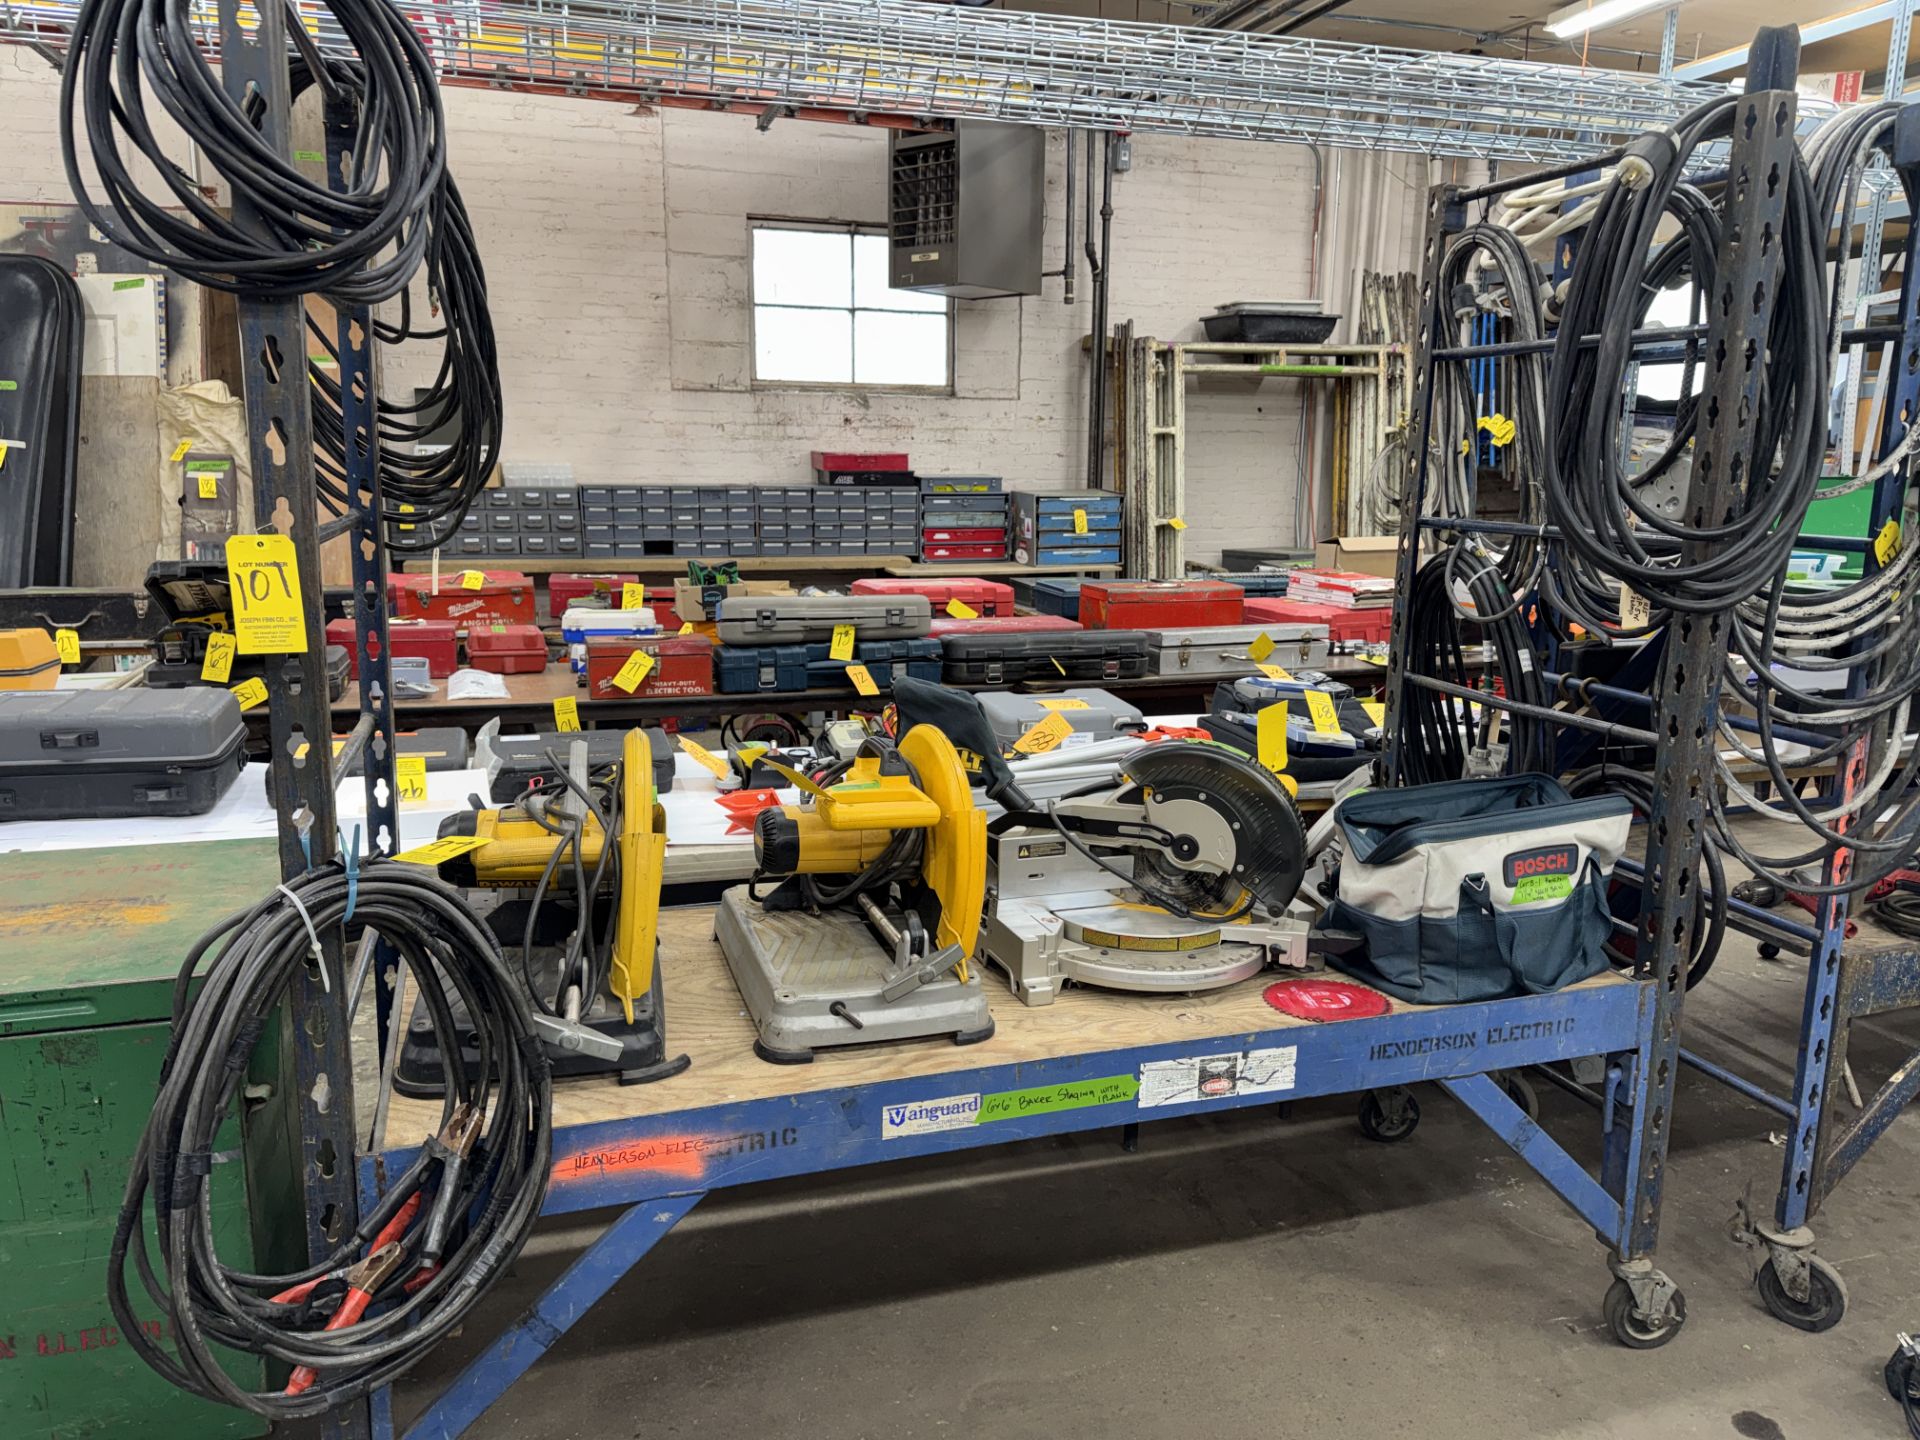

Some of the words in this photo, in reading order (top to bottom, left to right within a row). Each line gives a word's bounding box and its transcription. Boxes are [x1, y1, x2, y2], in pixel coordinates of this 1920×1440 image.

[1513, 852, 1569, 878] BOSCH
[1369, 1031, 1477, 1061] HENDERSON
[1486, 1017, 1577, 1046] ELECTRIC
[886, 1096, 979, 1128] Vanguard
[574, 1146, 657, 1171] HENDERSON
